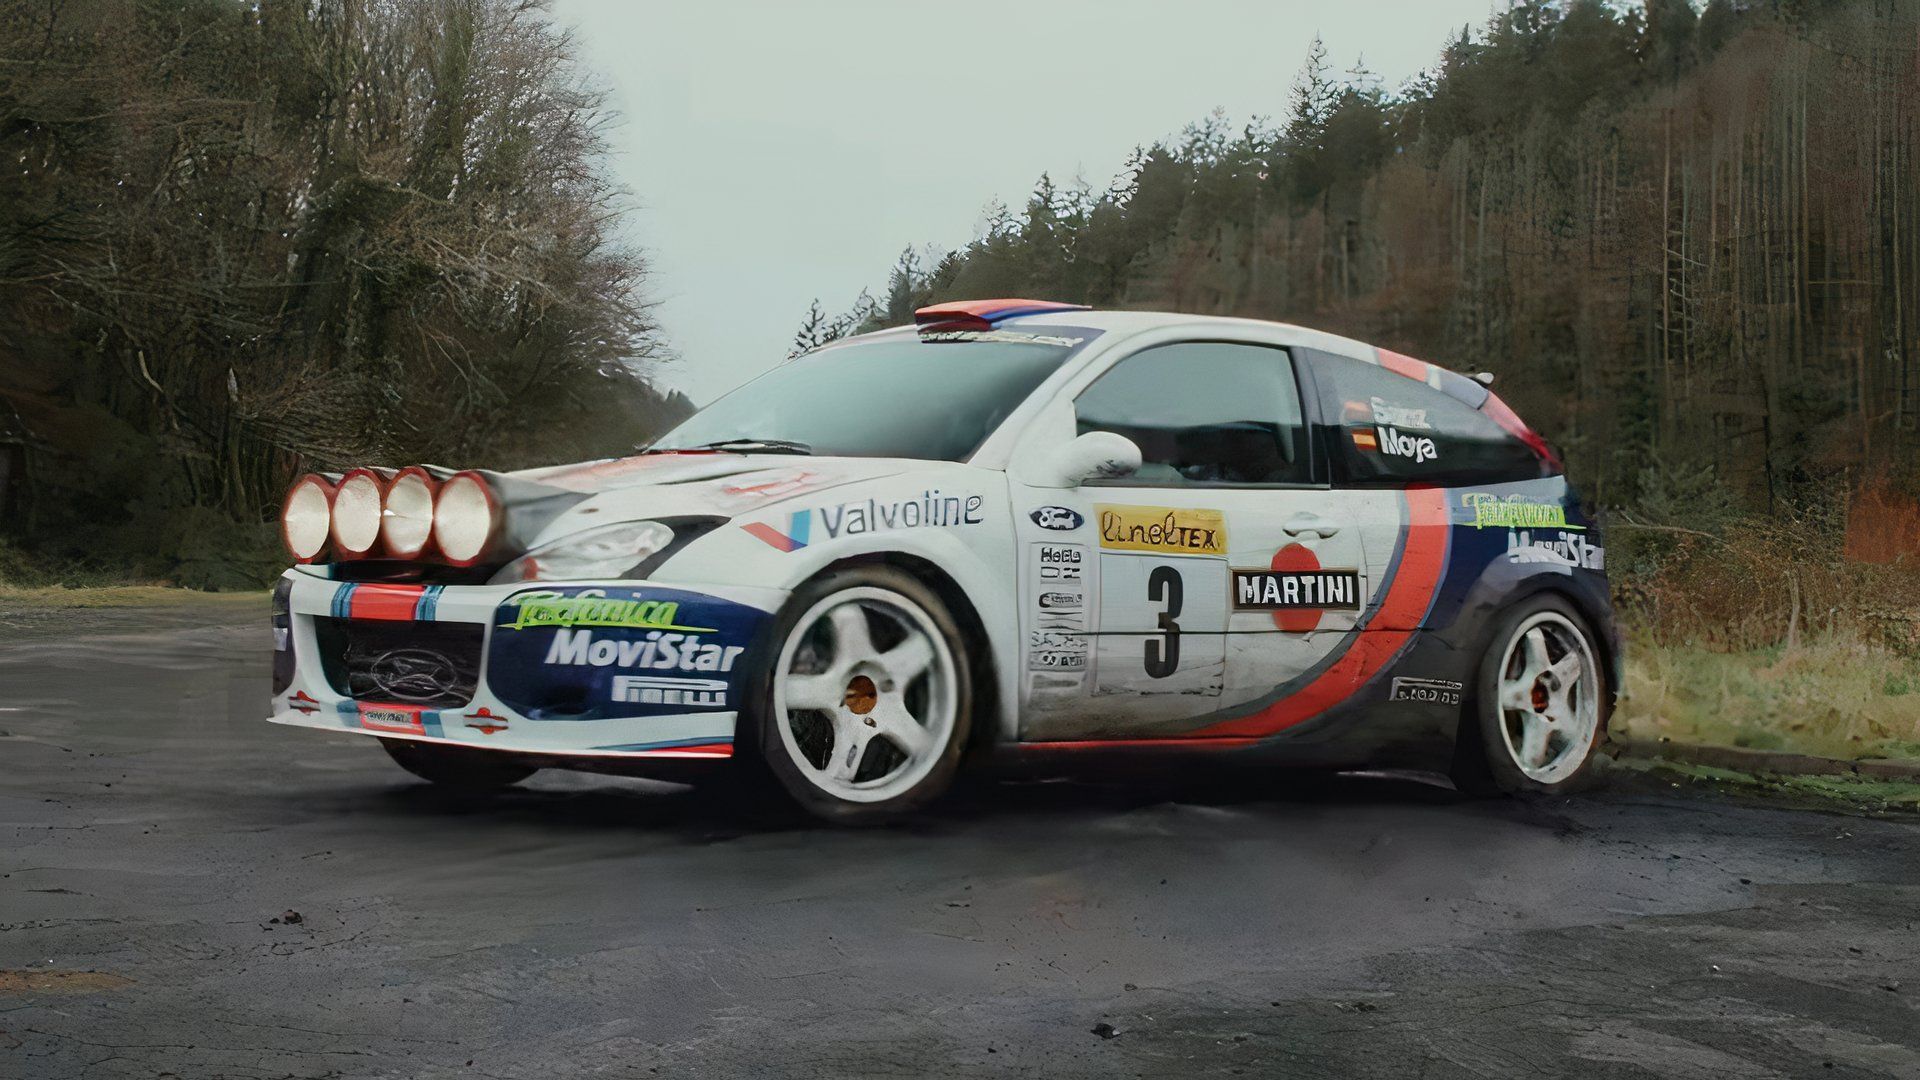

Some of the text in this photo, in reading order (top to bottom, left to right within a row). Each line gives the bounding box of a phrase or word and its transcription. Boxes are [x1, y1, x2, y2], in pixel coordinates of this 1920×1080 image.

[1377, 426, 1438, 463] Moya
[820, 489, 984, 539] Valvoline
[1238, 575, 1354, 605] MARTINI
[1143, 565, 1183, 679] 3
[544, 628, 745, 672] MoviStar
